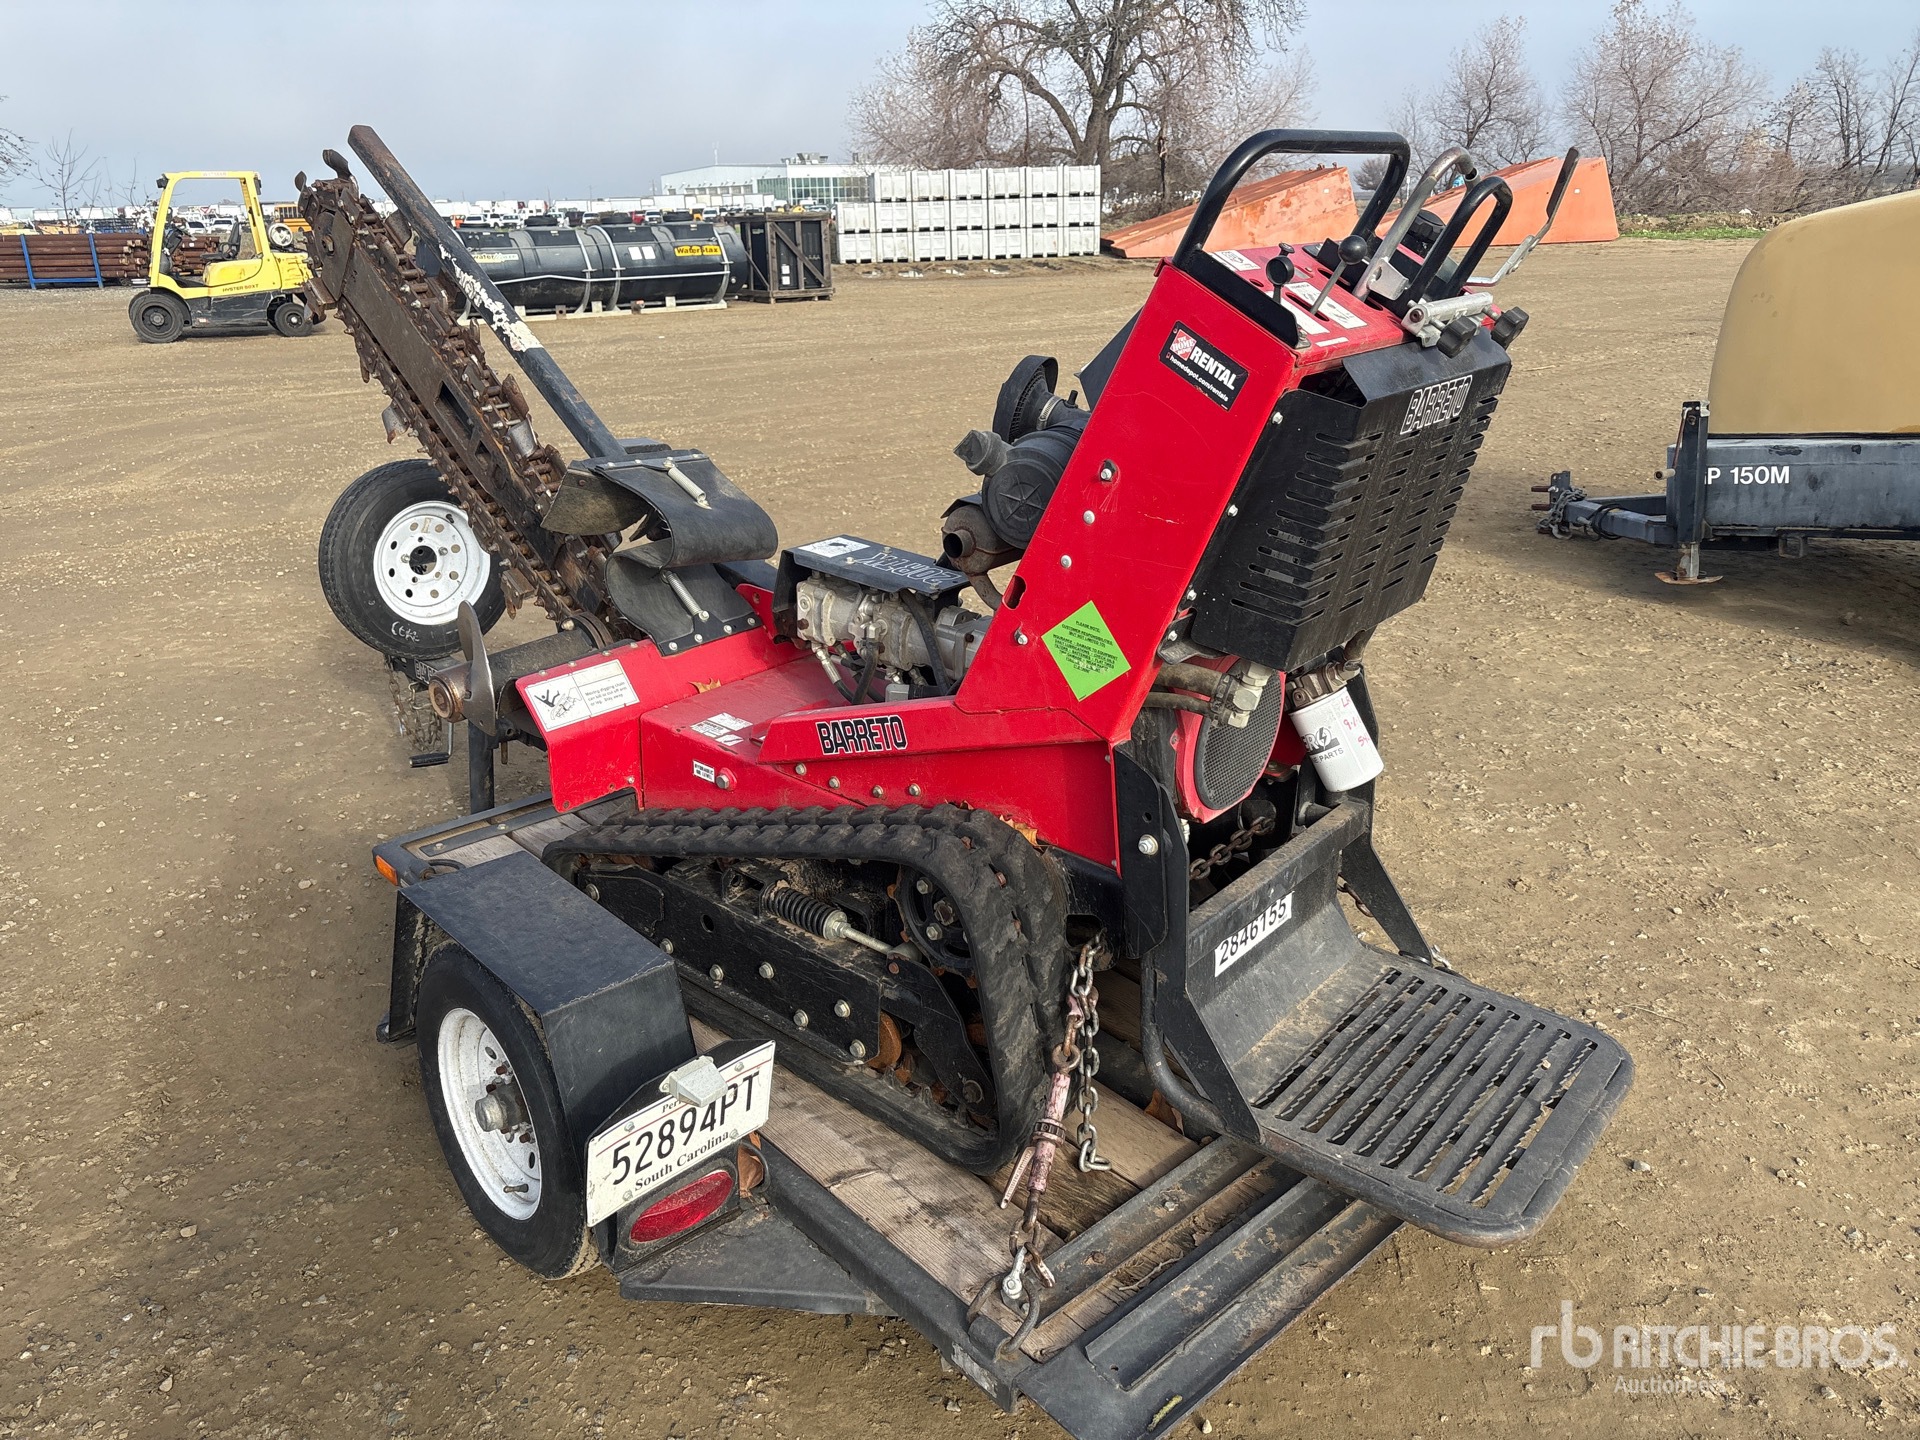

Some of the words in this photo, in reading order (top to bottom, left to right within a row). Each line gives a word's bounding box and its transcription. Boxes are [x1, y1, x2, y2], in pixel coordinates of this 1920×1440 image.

[1172, 339, 1194, 350] HOME
[1170, 355, 1228, 402] homedepot.com/rentals
[1190, 346, 1236, 390] RENTAL
[1400, 374, 1472, 434] BARRETO
[1730, 466, 1790, 485] 150M
[815, 714, 908, 755] BARRETO
[1319, 748, 1344, 762] PARTS
[1219, 896, 1286, 966] 2846155
[612, 1071, 760, 1186] 52894PT
[635, 1165, 672, 1192] South
[676, 1130, 729, 1167] Carolina
